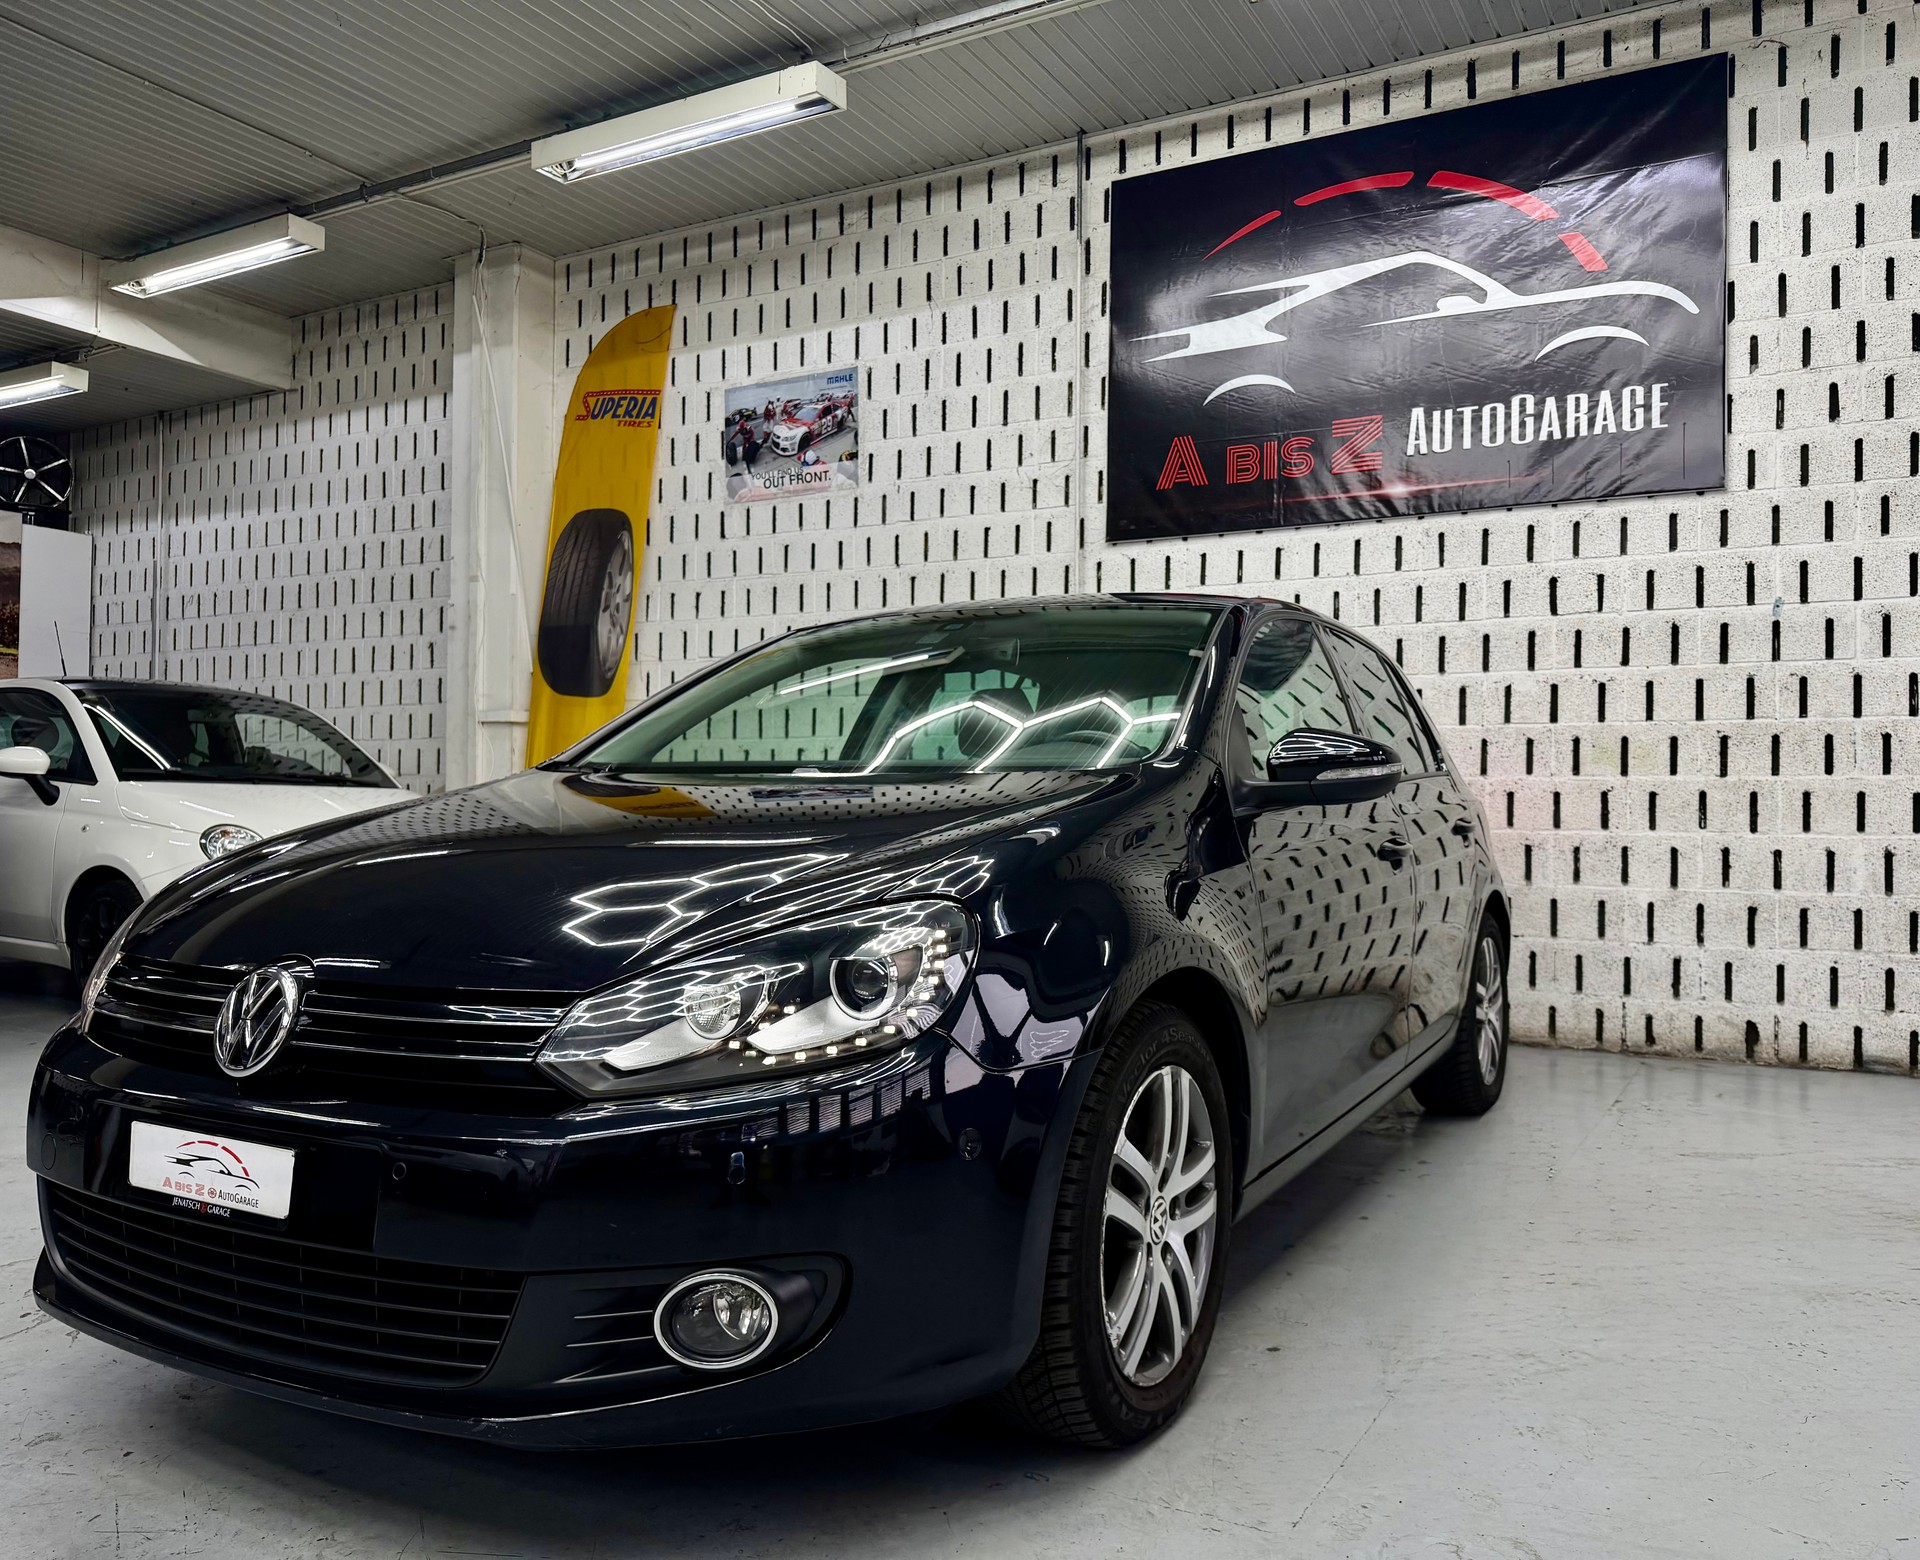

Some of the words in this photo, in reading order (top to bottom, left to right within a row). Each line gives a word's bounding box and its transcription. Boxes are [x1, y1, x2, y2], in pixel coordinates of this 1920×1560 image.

[827, 374, 853, 385] MAHLE
[575, 389, 661, 421] SUPERIA
[617, 420, 653, 428] TIRES
[1156, 434, 1208, 490] A
[1225, 436, 1315, 485] BIS
[1331, 414, 1384, 475] Z
[763, 477, 786, 489] OUT
[789, 470, 831, 486] FRONT.
[162, 1176, 173, 1188] A
[174, 1181, 193, 1193] BIS
[194, 1183, 205, 1197] Z
[172, 1197, 200, 1210] JENATSCH
[207, 1204, 231, 1217] GARAGE
